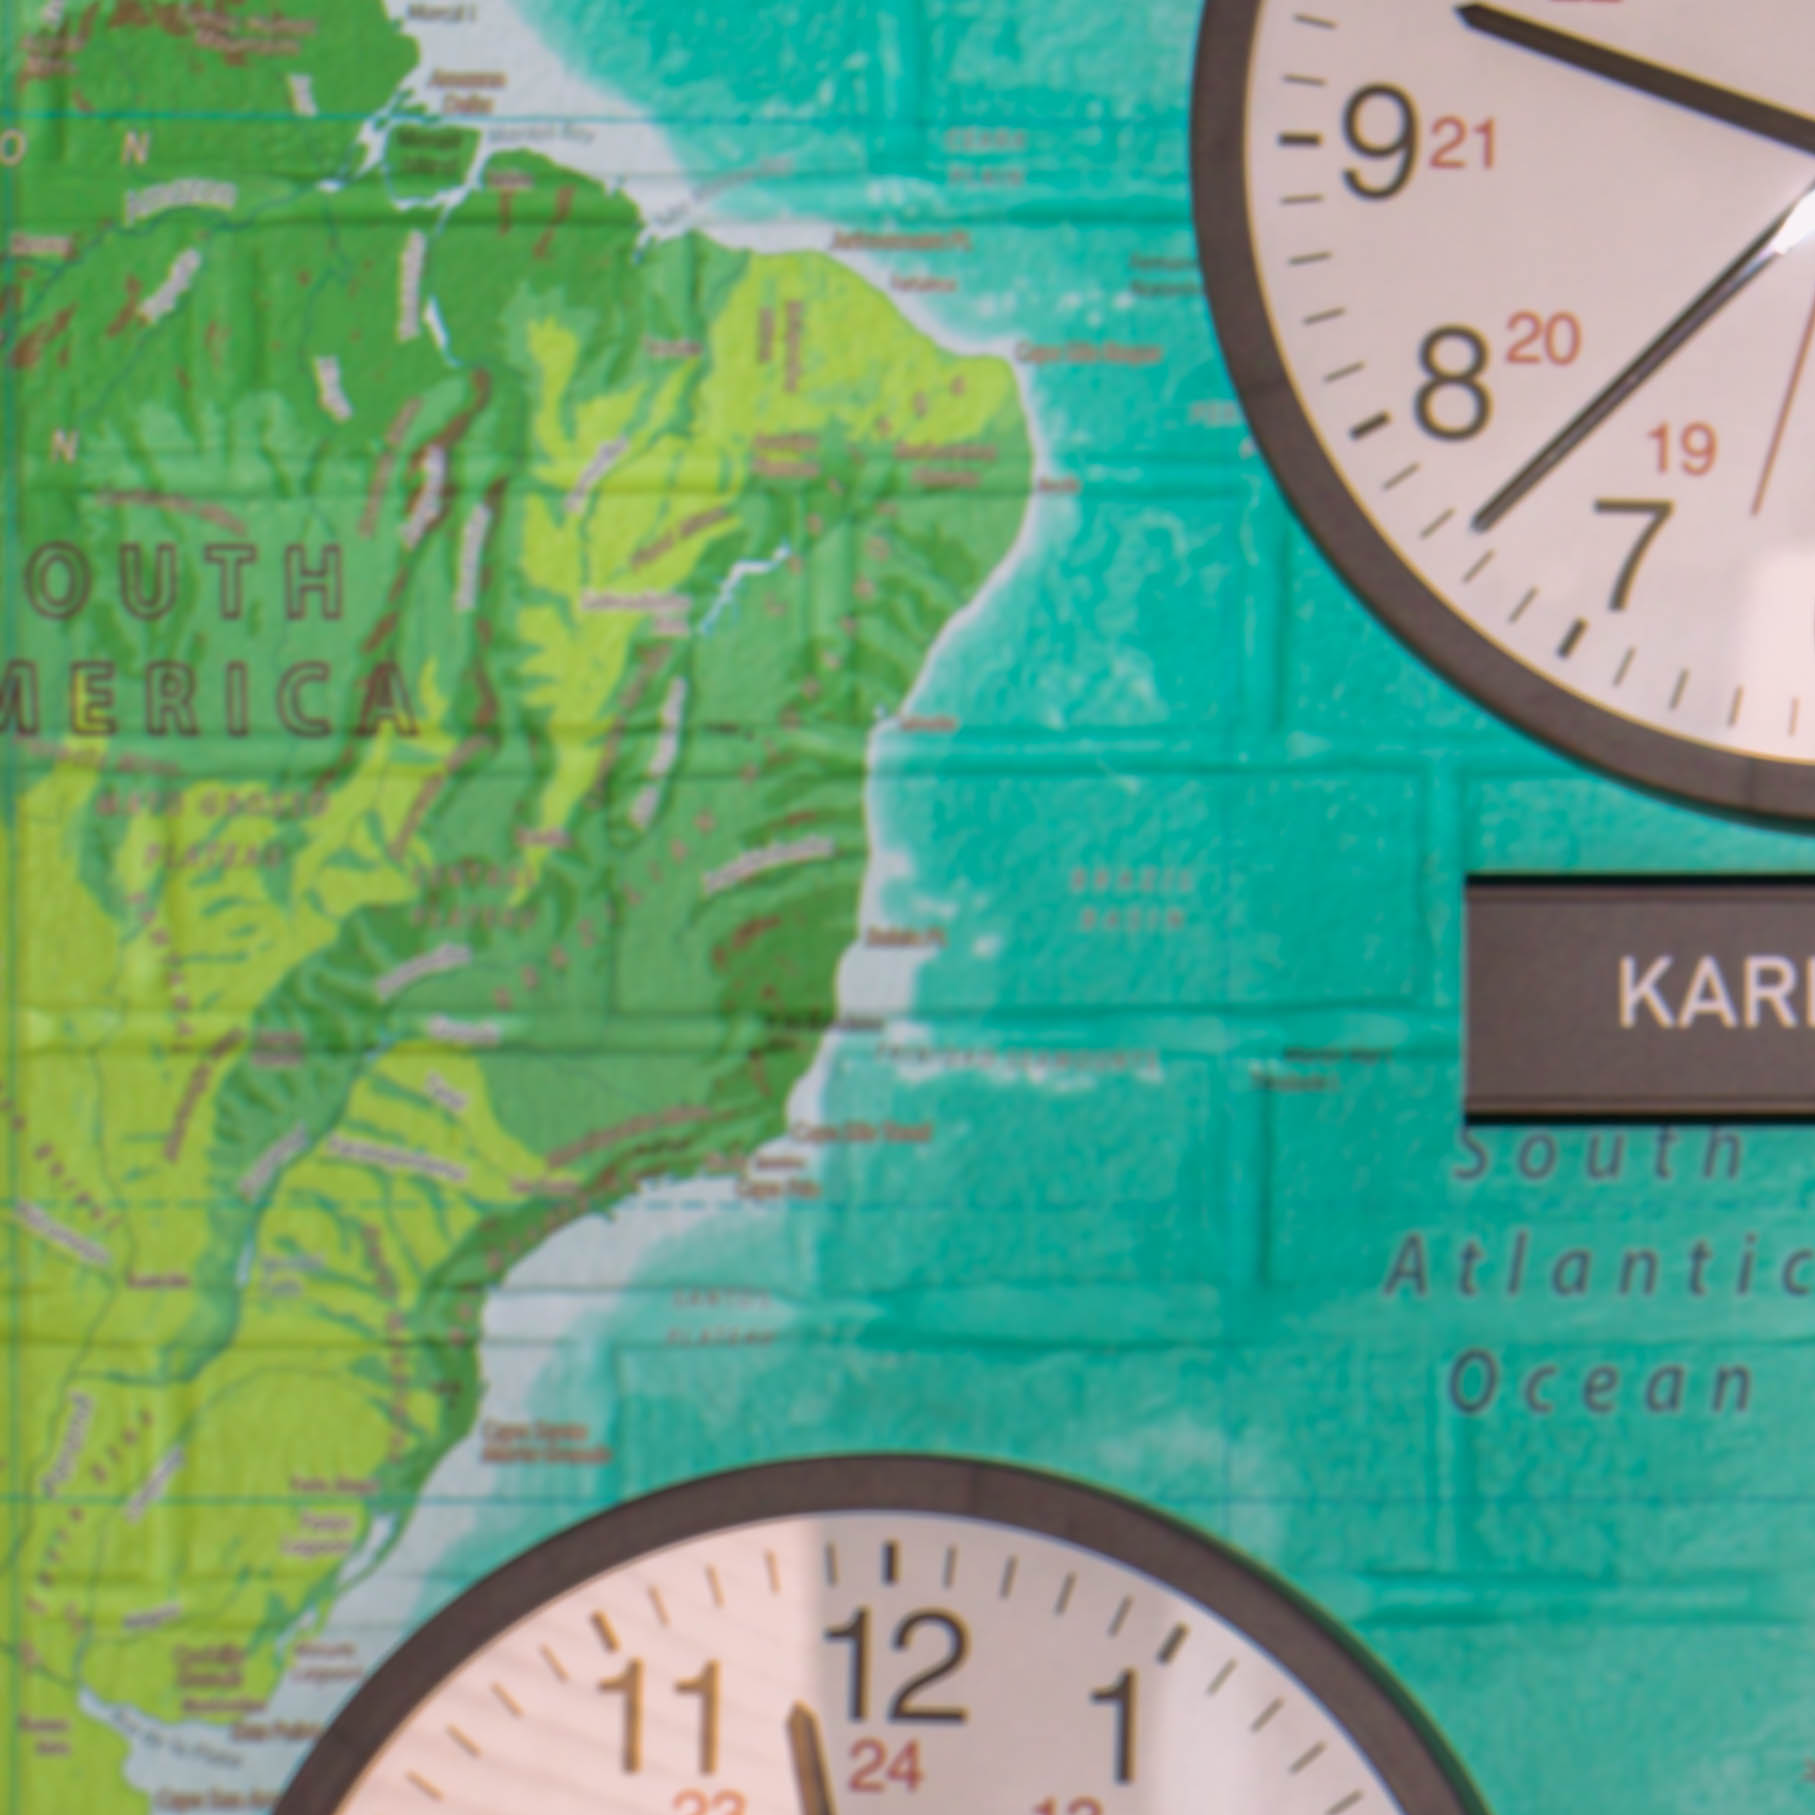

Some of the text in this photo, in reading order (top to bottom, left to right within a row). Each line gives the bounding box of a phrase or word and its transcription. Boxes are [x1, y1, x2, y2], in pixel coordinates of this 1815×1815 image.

[1341, 82, 1420, 202] 9
[1427, 114, 1496, 171] 21
[1413, 324, 1493, 443] 8
[1505, 310, 1583, 368] 20
[1649, 421, 1718, 477] 19
[1593, 497, 1674, 613] 7
[1450, 1127, 1746, 1182] South
[1447, 1347, 1756, 1416] Ocean
[825, 1607, 970, 1725] 12
[597, 1658, 720, 1776] 11
[1091, 1668, 1137, 1785] 1
[848, 1738, 924, 1793] 24
